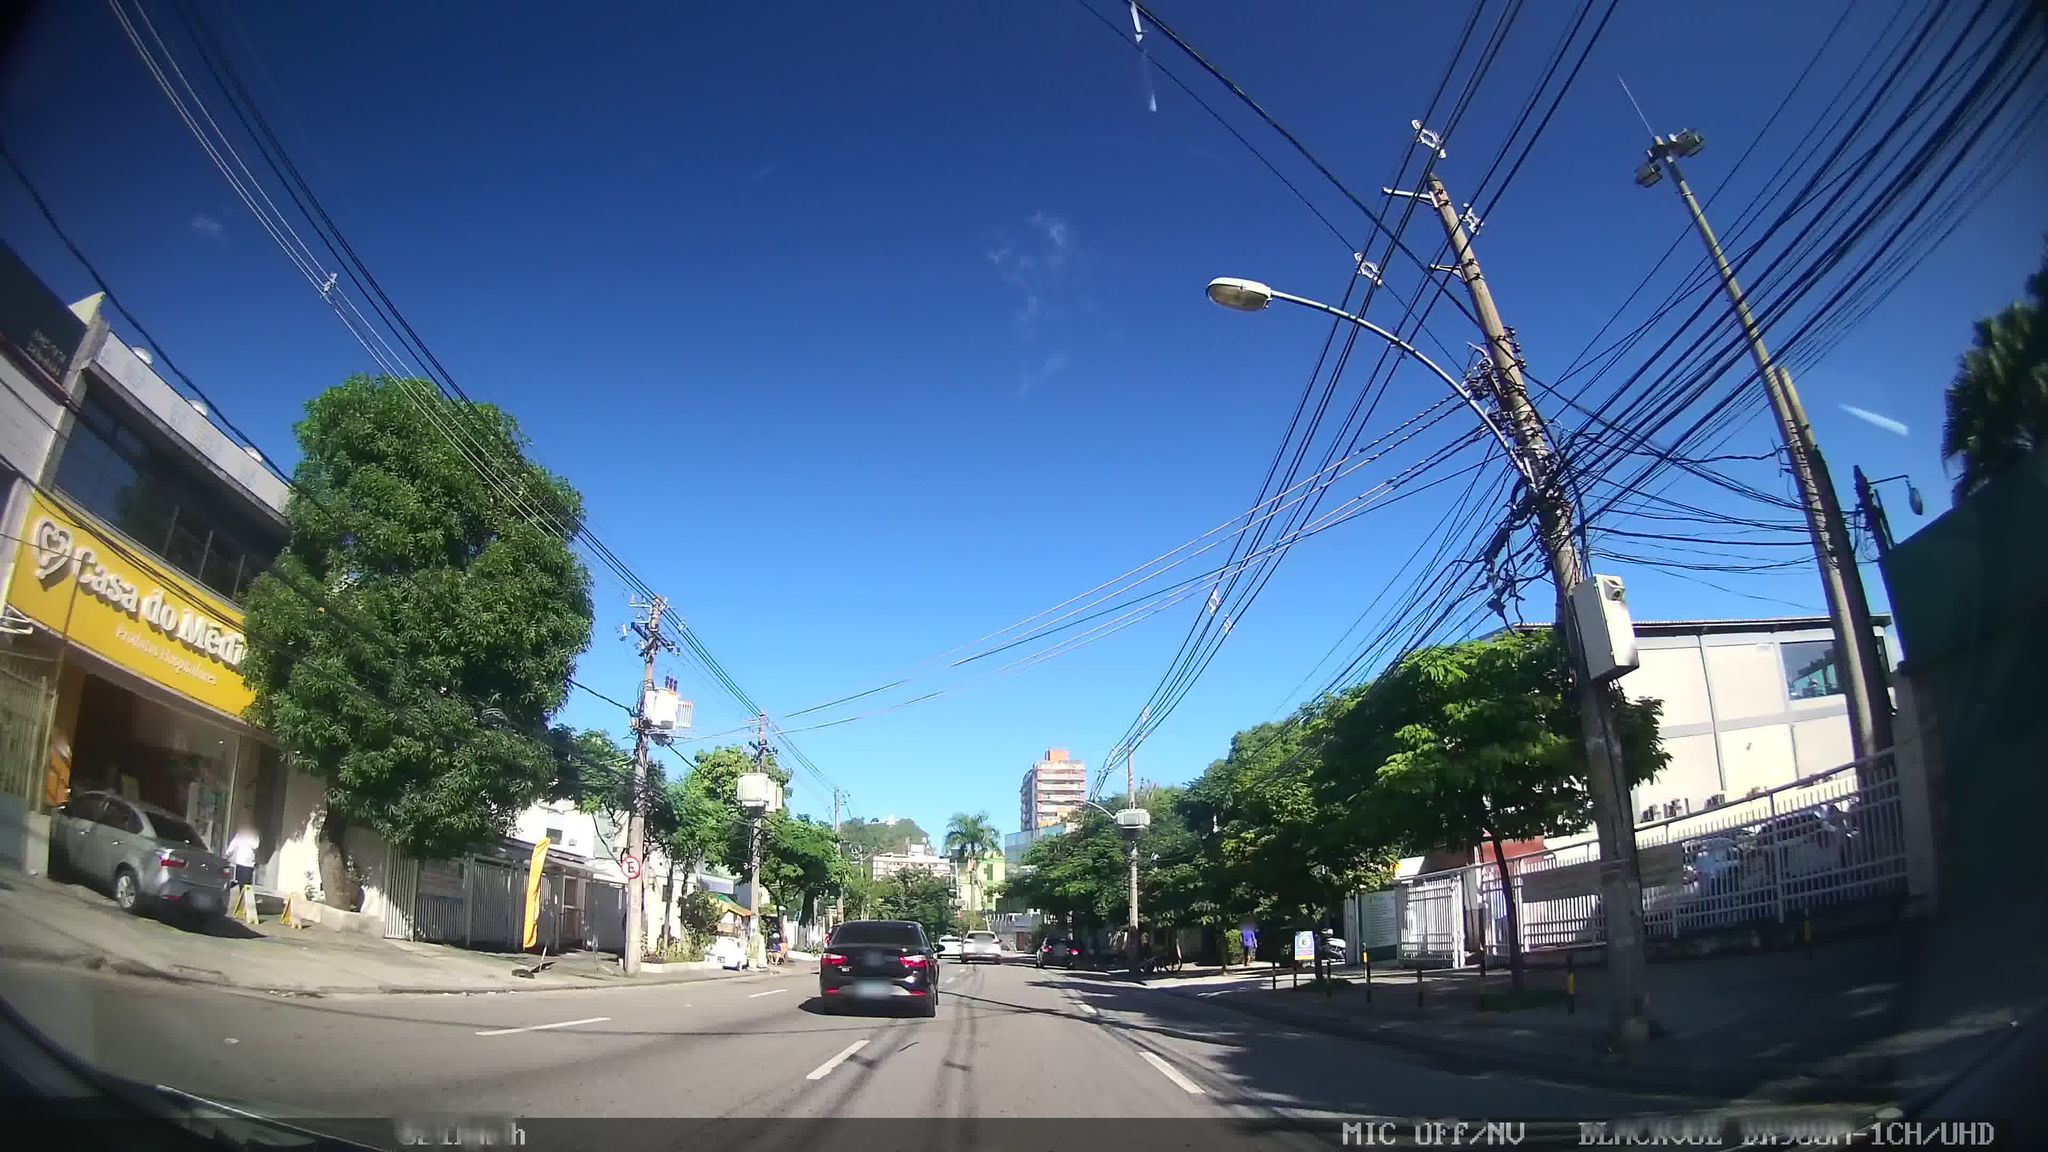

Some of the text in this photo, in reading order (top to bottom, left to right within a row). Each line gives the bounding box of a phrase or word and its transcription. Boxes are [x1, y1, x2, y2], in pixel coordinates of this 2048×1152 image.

[72, 545, 248, 666] Casa do Médi
[628, 861, 635, 873] E
